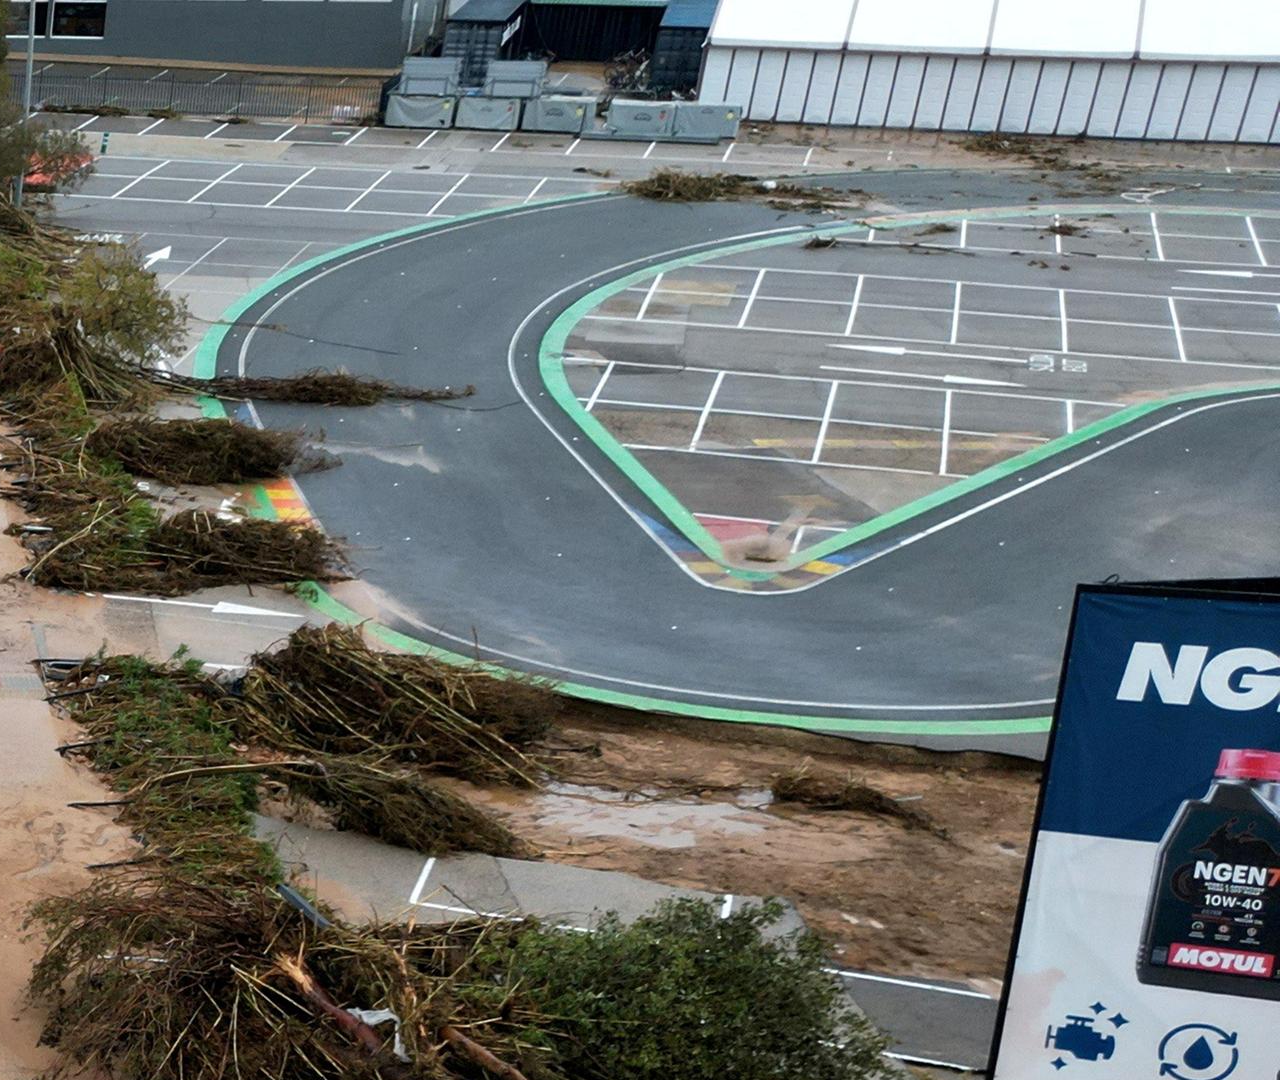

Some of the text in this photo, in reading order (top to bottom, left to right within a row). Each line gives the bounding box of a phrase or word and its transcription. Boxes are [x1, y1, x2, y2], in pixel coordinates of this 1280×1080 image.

[1116, 641, 1280, 712] NG
[1205, 894, 1262, 911] 10W-40
[1173, 948, 1266, 973] MOTUL
